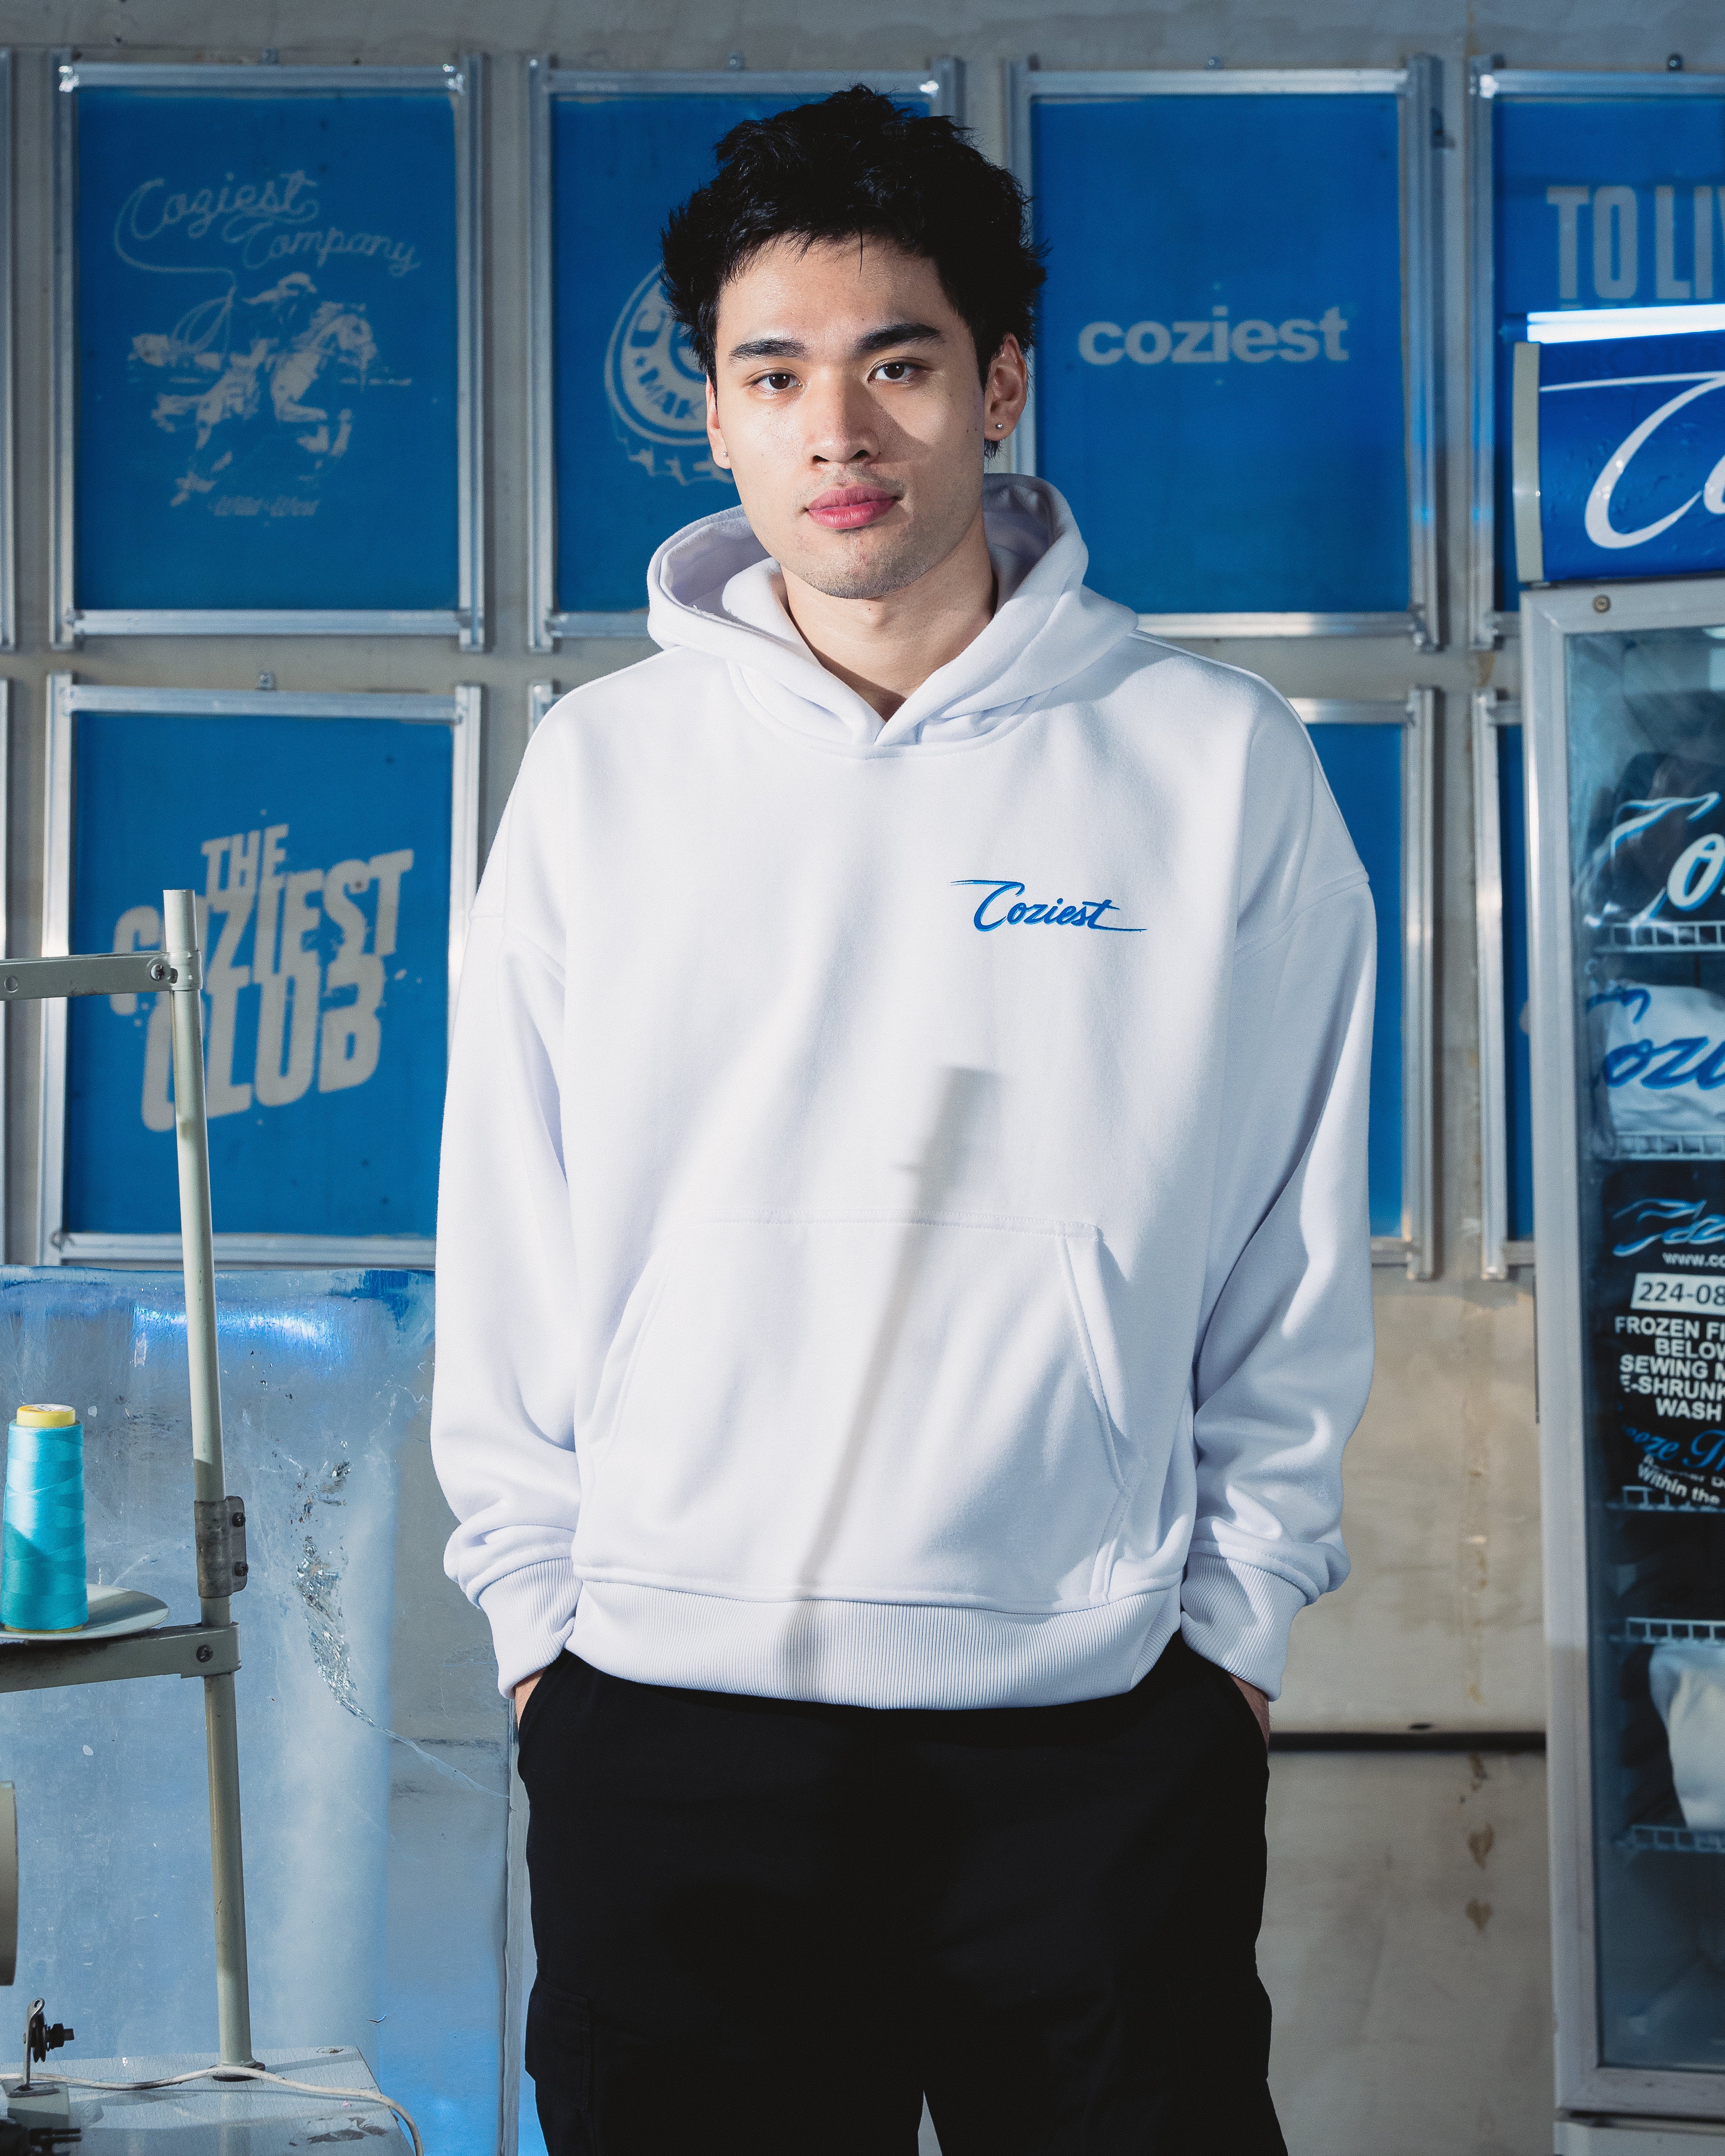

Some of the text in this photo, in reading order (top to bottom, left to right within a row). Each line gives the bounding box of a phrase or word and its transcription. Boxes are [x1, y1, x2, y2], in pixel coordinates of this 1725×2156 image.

[222, 217, 420, 277] Company
[1546, 185, 1725, 300] TO LI
[1078, 305, 1350, 365] coziest
[201, 824, 289, 894] THE
[950, 879, 1147, 932] Coziest
[1614, 1316, 1700, 1340] FROZEN
[1620, 1353, 1709, 1379] SEWING
[1655, 1397, 1722, 1422] WASH
